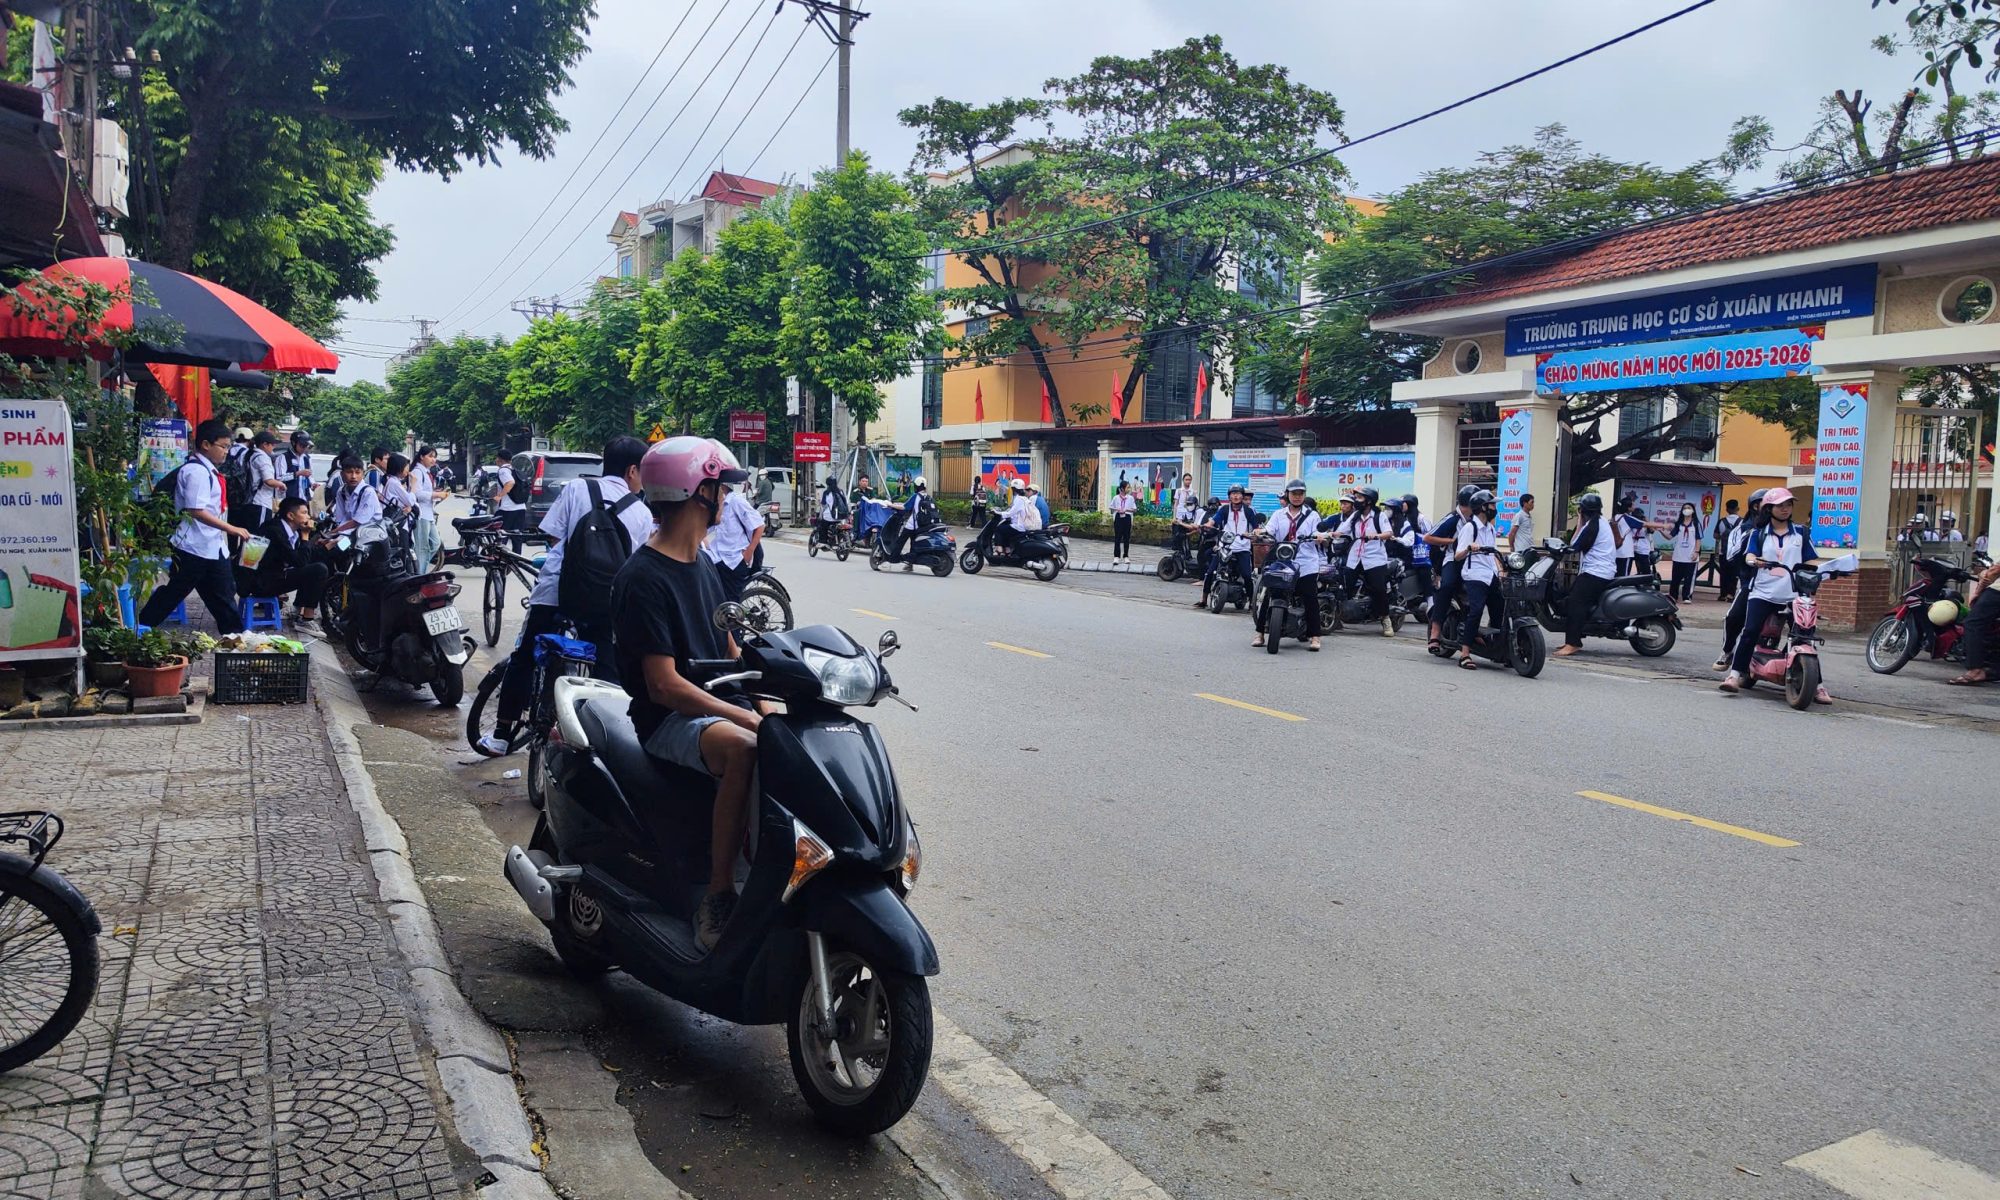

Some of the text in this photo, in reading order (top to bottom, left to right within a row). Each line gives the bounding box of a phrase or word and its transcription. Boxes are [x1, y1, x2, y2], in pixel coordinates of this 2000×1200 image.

[1524, 320, 1577, 343] TRƯỜNG
[1581, 315, 1628, 336] TRUNG
[1632, 310, 1663, 332] HỌC
[1668, 304, 1691, 325] CƠ
[1696, 296, 1719, 322] SỞ
[1722, 293, 1772, 318] XUÂN
[1777, 286, 1844, 312] KHANH
[1544, 342, 1811, 384] CHÀO MỪNG NĂM HỌC MỚI 2025-2026
[2, 409, 36, 419] SINH
[4, 426, 65, 446] PHẨM
[1339, 473, 1355, 484] 20
[1364, 473, 1373, 484] 11
[0, 494, 16, 506] OA
[19, 492, 31, 506] CŨ
[41, 491, 63, 506] MỚI
[0, 536, 57, 544] 972.360.199
[428, 608, 454, 622] 29-U1
[430, 618, 459, 634] 372.47
